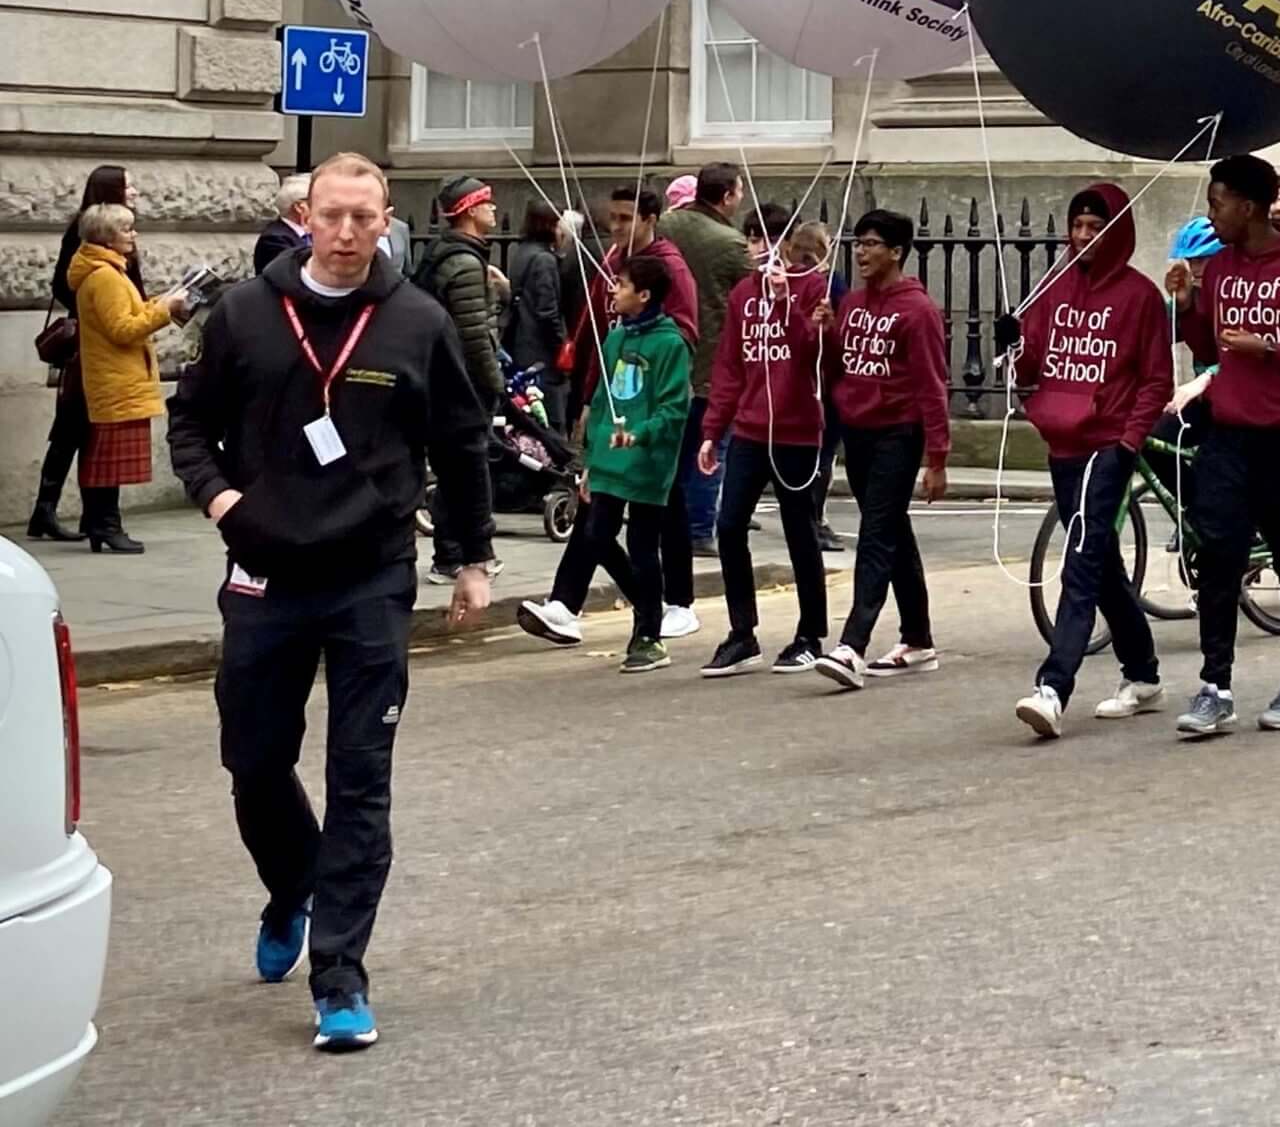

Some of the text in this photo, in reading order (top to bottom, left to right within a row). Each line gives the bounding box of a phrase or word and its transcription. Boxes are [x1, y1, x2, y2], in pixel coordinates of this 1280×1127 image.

[905, 6, 969, 44] Society
[1219, 275, 1255, 304] City
[743, 297, 775, 324] Cty
[848, 307, 900, 335] City of
[1088, 306, 1113, 330] of
[742, 319, 786, 340] Lond
[1048, 328, 1117, 358] London
[842, 352, 891, 377] School
[1044, 353, 1106, 384] School
